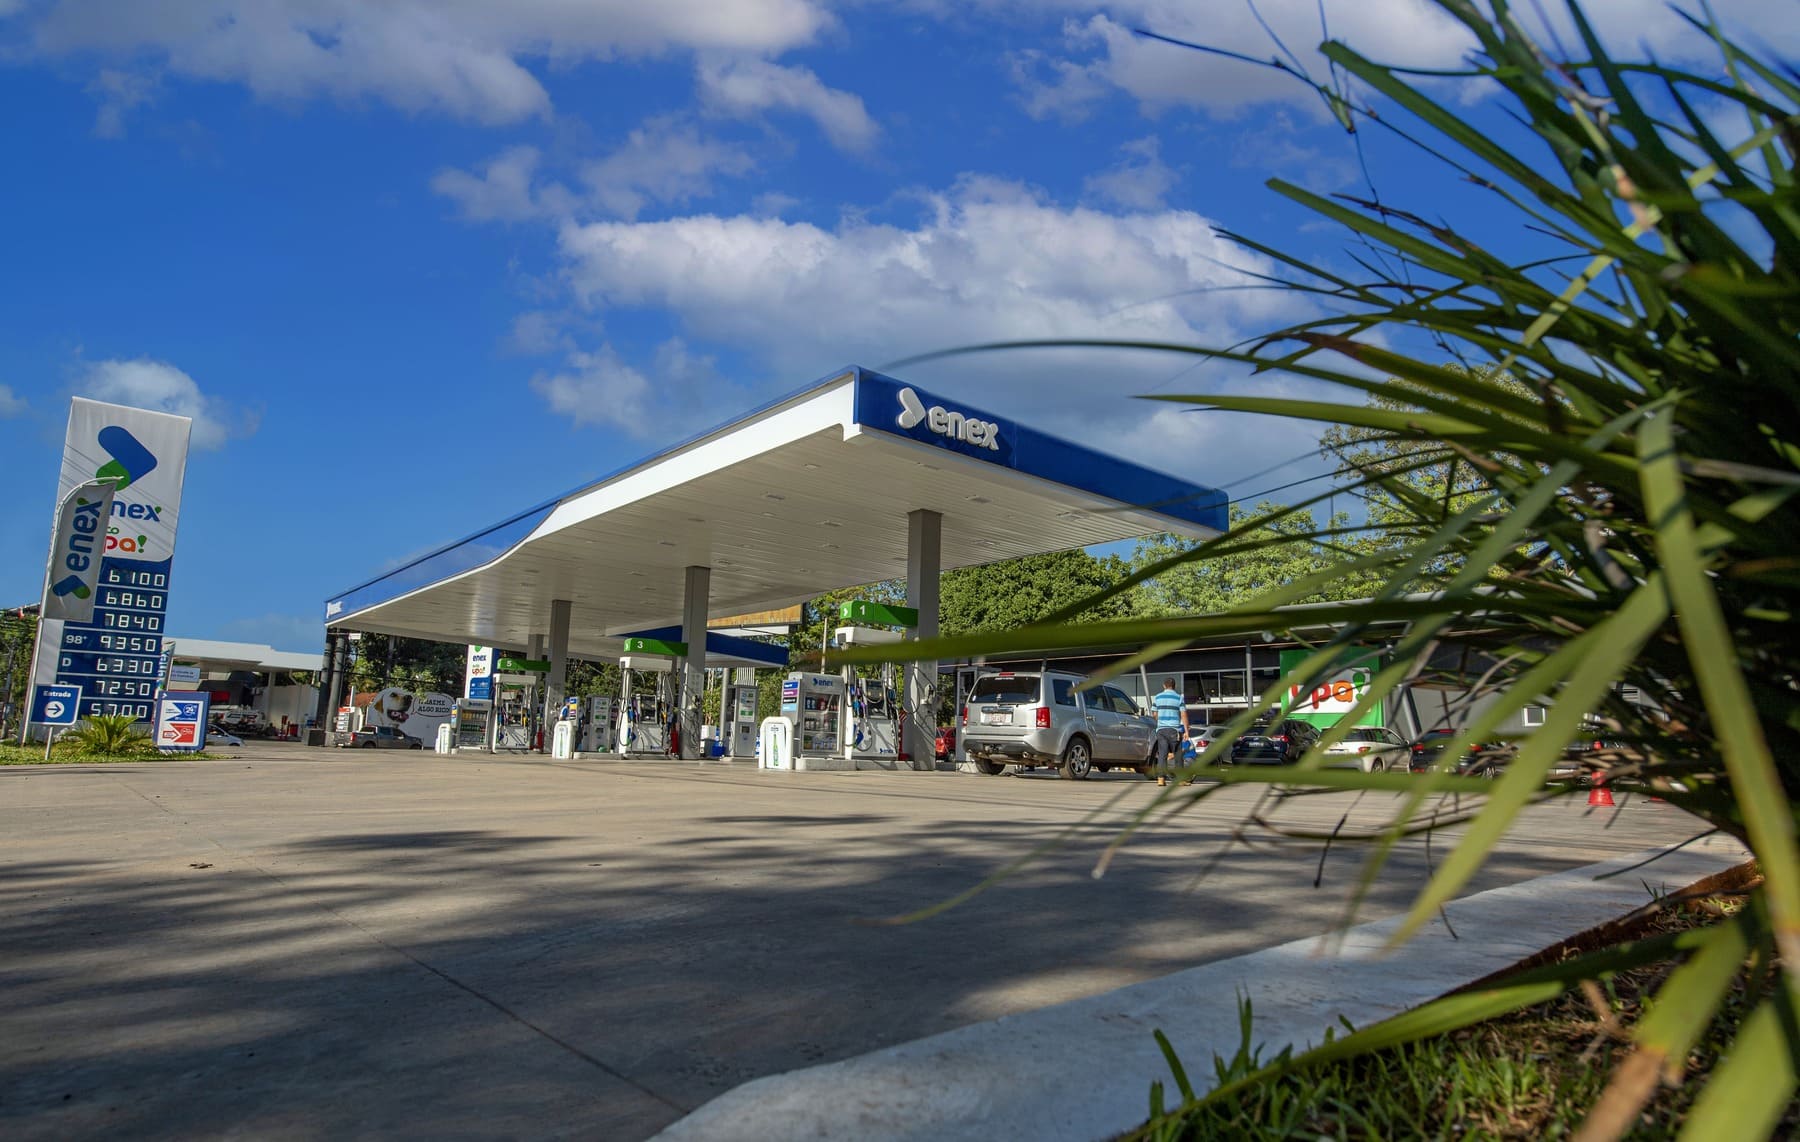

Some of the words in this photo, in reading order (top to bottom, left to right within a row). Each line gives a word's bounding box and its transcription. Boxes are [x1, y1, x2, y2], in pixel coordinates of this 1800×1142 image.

[928, 406, 999, 451] enex
[109, 500, 162, 522] nex
[66, 497, 103, 572] enex
[103, 534, 147, 553] pa!
[108, 569, 165, 587] 6100
[106, 592, 162, 609] 6860
[859, 605, 866, 615] 1
[104, 613, 160, 631] 7840
[100, 635, 157, 652] 9350
[637, 640, 644, 649] 3
[62, 657, 72, 667] D
[96, 658, 154, 675] 6330
[43, 690, 72, 698] Entrada
[95, 680, 151, 697] 7250
[90, 703, 148, 719] 5700
